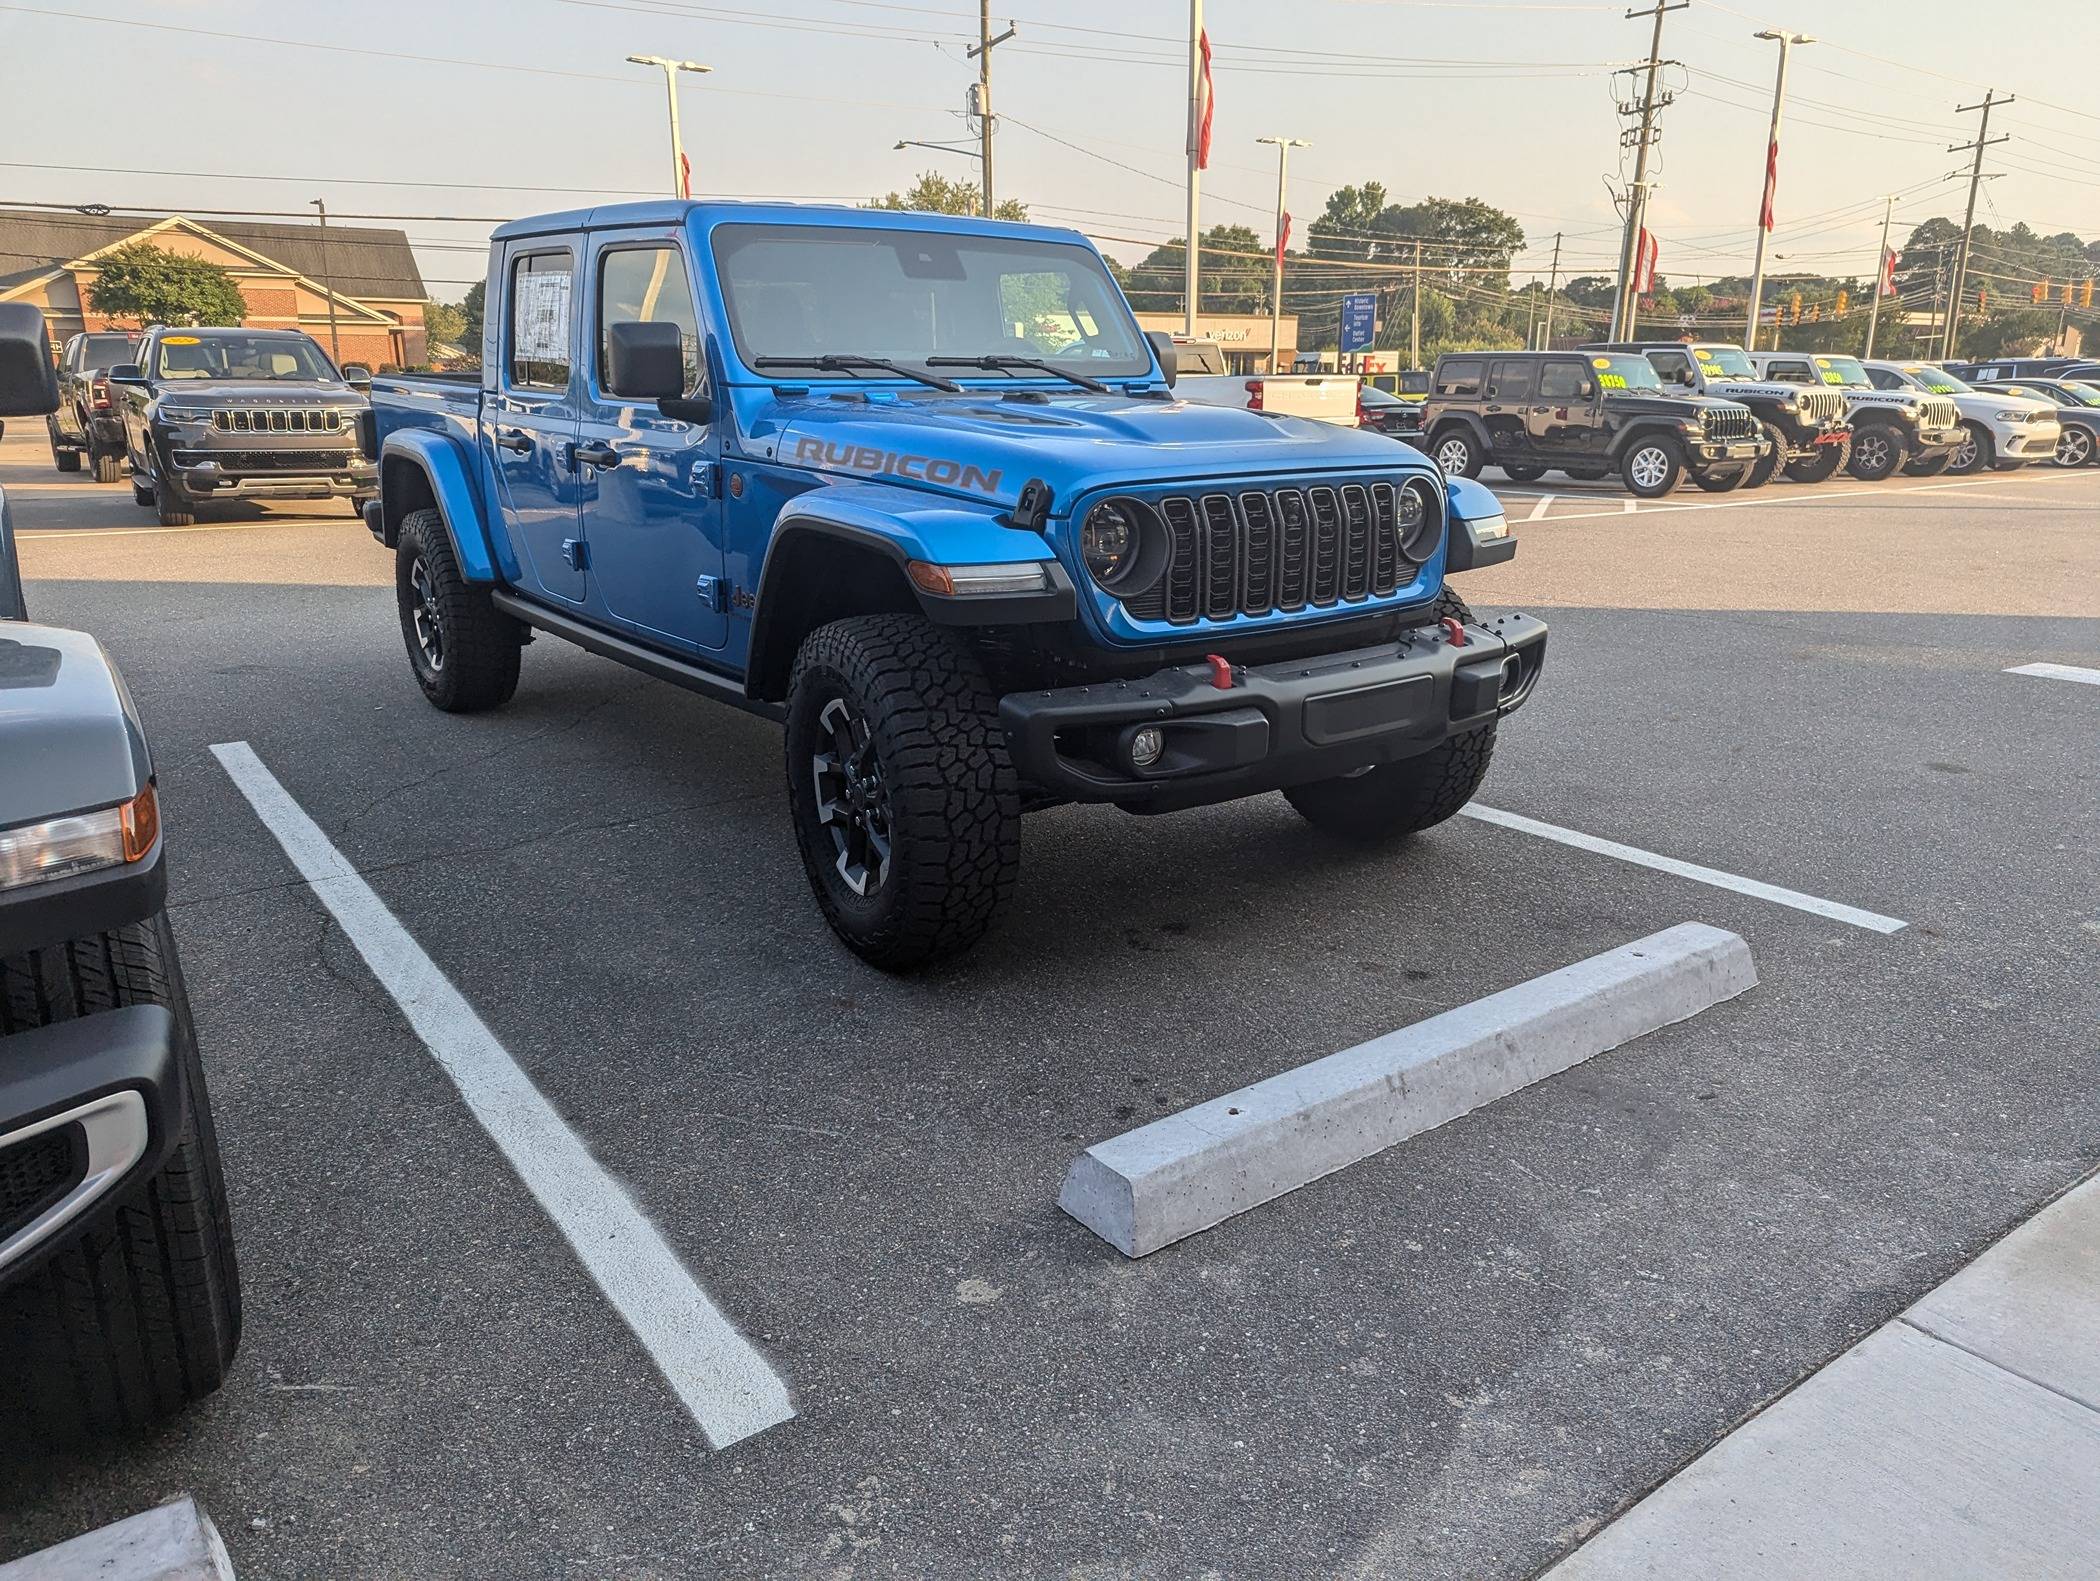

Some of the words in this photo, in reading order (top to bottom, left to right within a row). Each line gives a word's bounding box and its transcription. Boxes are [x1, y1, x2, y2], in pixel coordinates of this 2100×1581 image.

[1208, 328, 1247, 341] verizon
[1725, 388, 1784, 396] RUBICON
[1847, 395, 1904, 403] RUBICON
[795, 437, 1004, 494] RUBICON
[733, 584, 756, 608] Jee
